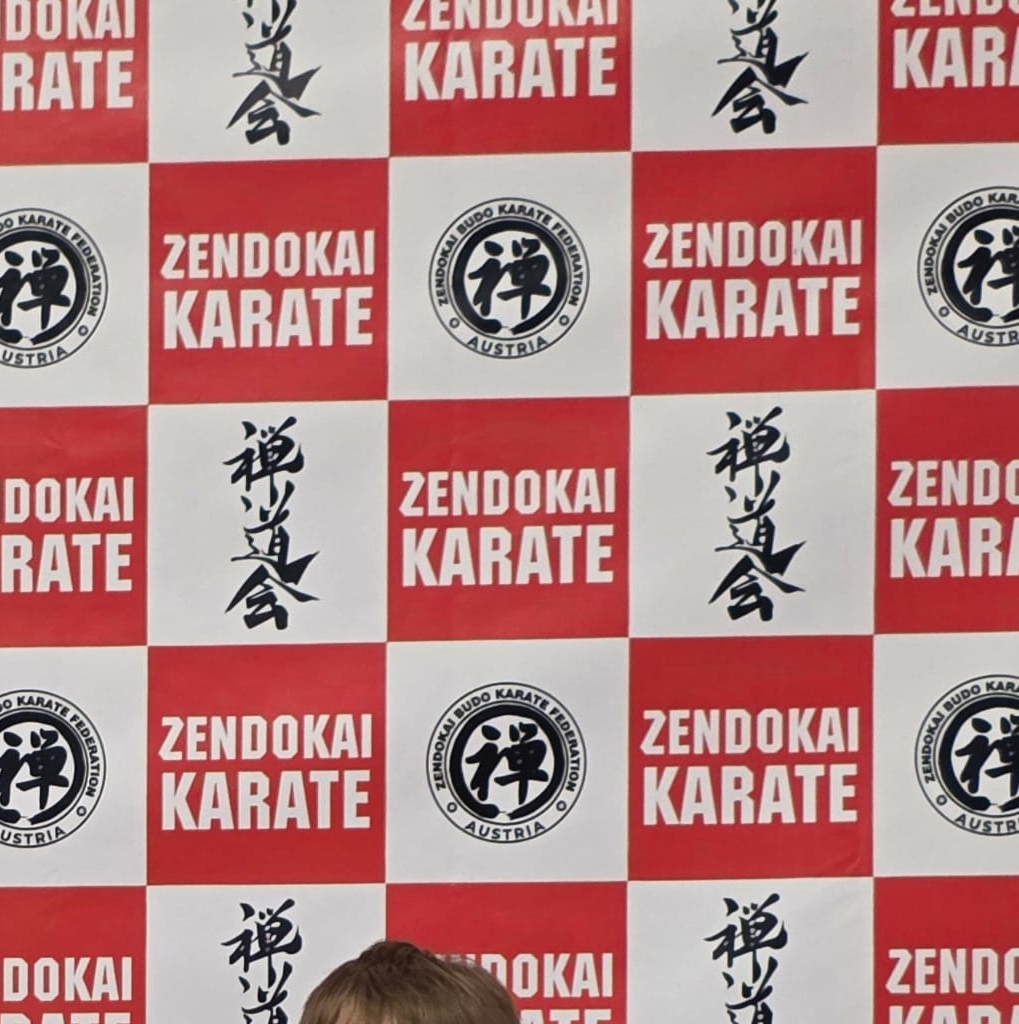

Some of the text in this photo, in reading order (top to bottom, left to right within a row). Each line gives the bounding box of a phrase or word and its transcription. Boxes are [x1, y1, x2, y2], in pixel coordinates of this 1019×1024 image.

[401, 0, 618, 31] ZENDOKAI
[404, 37, 616, 101] KARATE
[160, 230, 374, 279] ZENDOKAI
[435, 205, 583, 307] ZENDOKAI BUDO KARATE FEDERATION
[643, 220, 861, 268] ZENDOKAI
[164, 287, 373, 349] KARATE
[646, 277, 860, 339] KARATE
[468, 337, 548, 356] AUSTRIA
[399, 468, 615, 516] ZENDOKAI
[403, 525, 613, 587] KARATE
[17, 697, 69, 716] KARATE
[69, 715, 100, 797] FEDERATION
[158, 714, 372, 761] ZENDOKAI
[640, 707, 858, 755] ZENDOKAI
[162, 770, 370, 830] KARATE
[644, 764, 857, 825] KARATE
